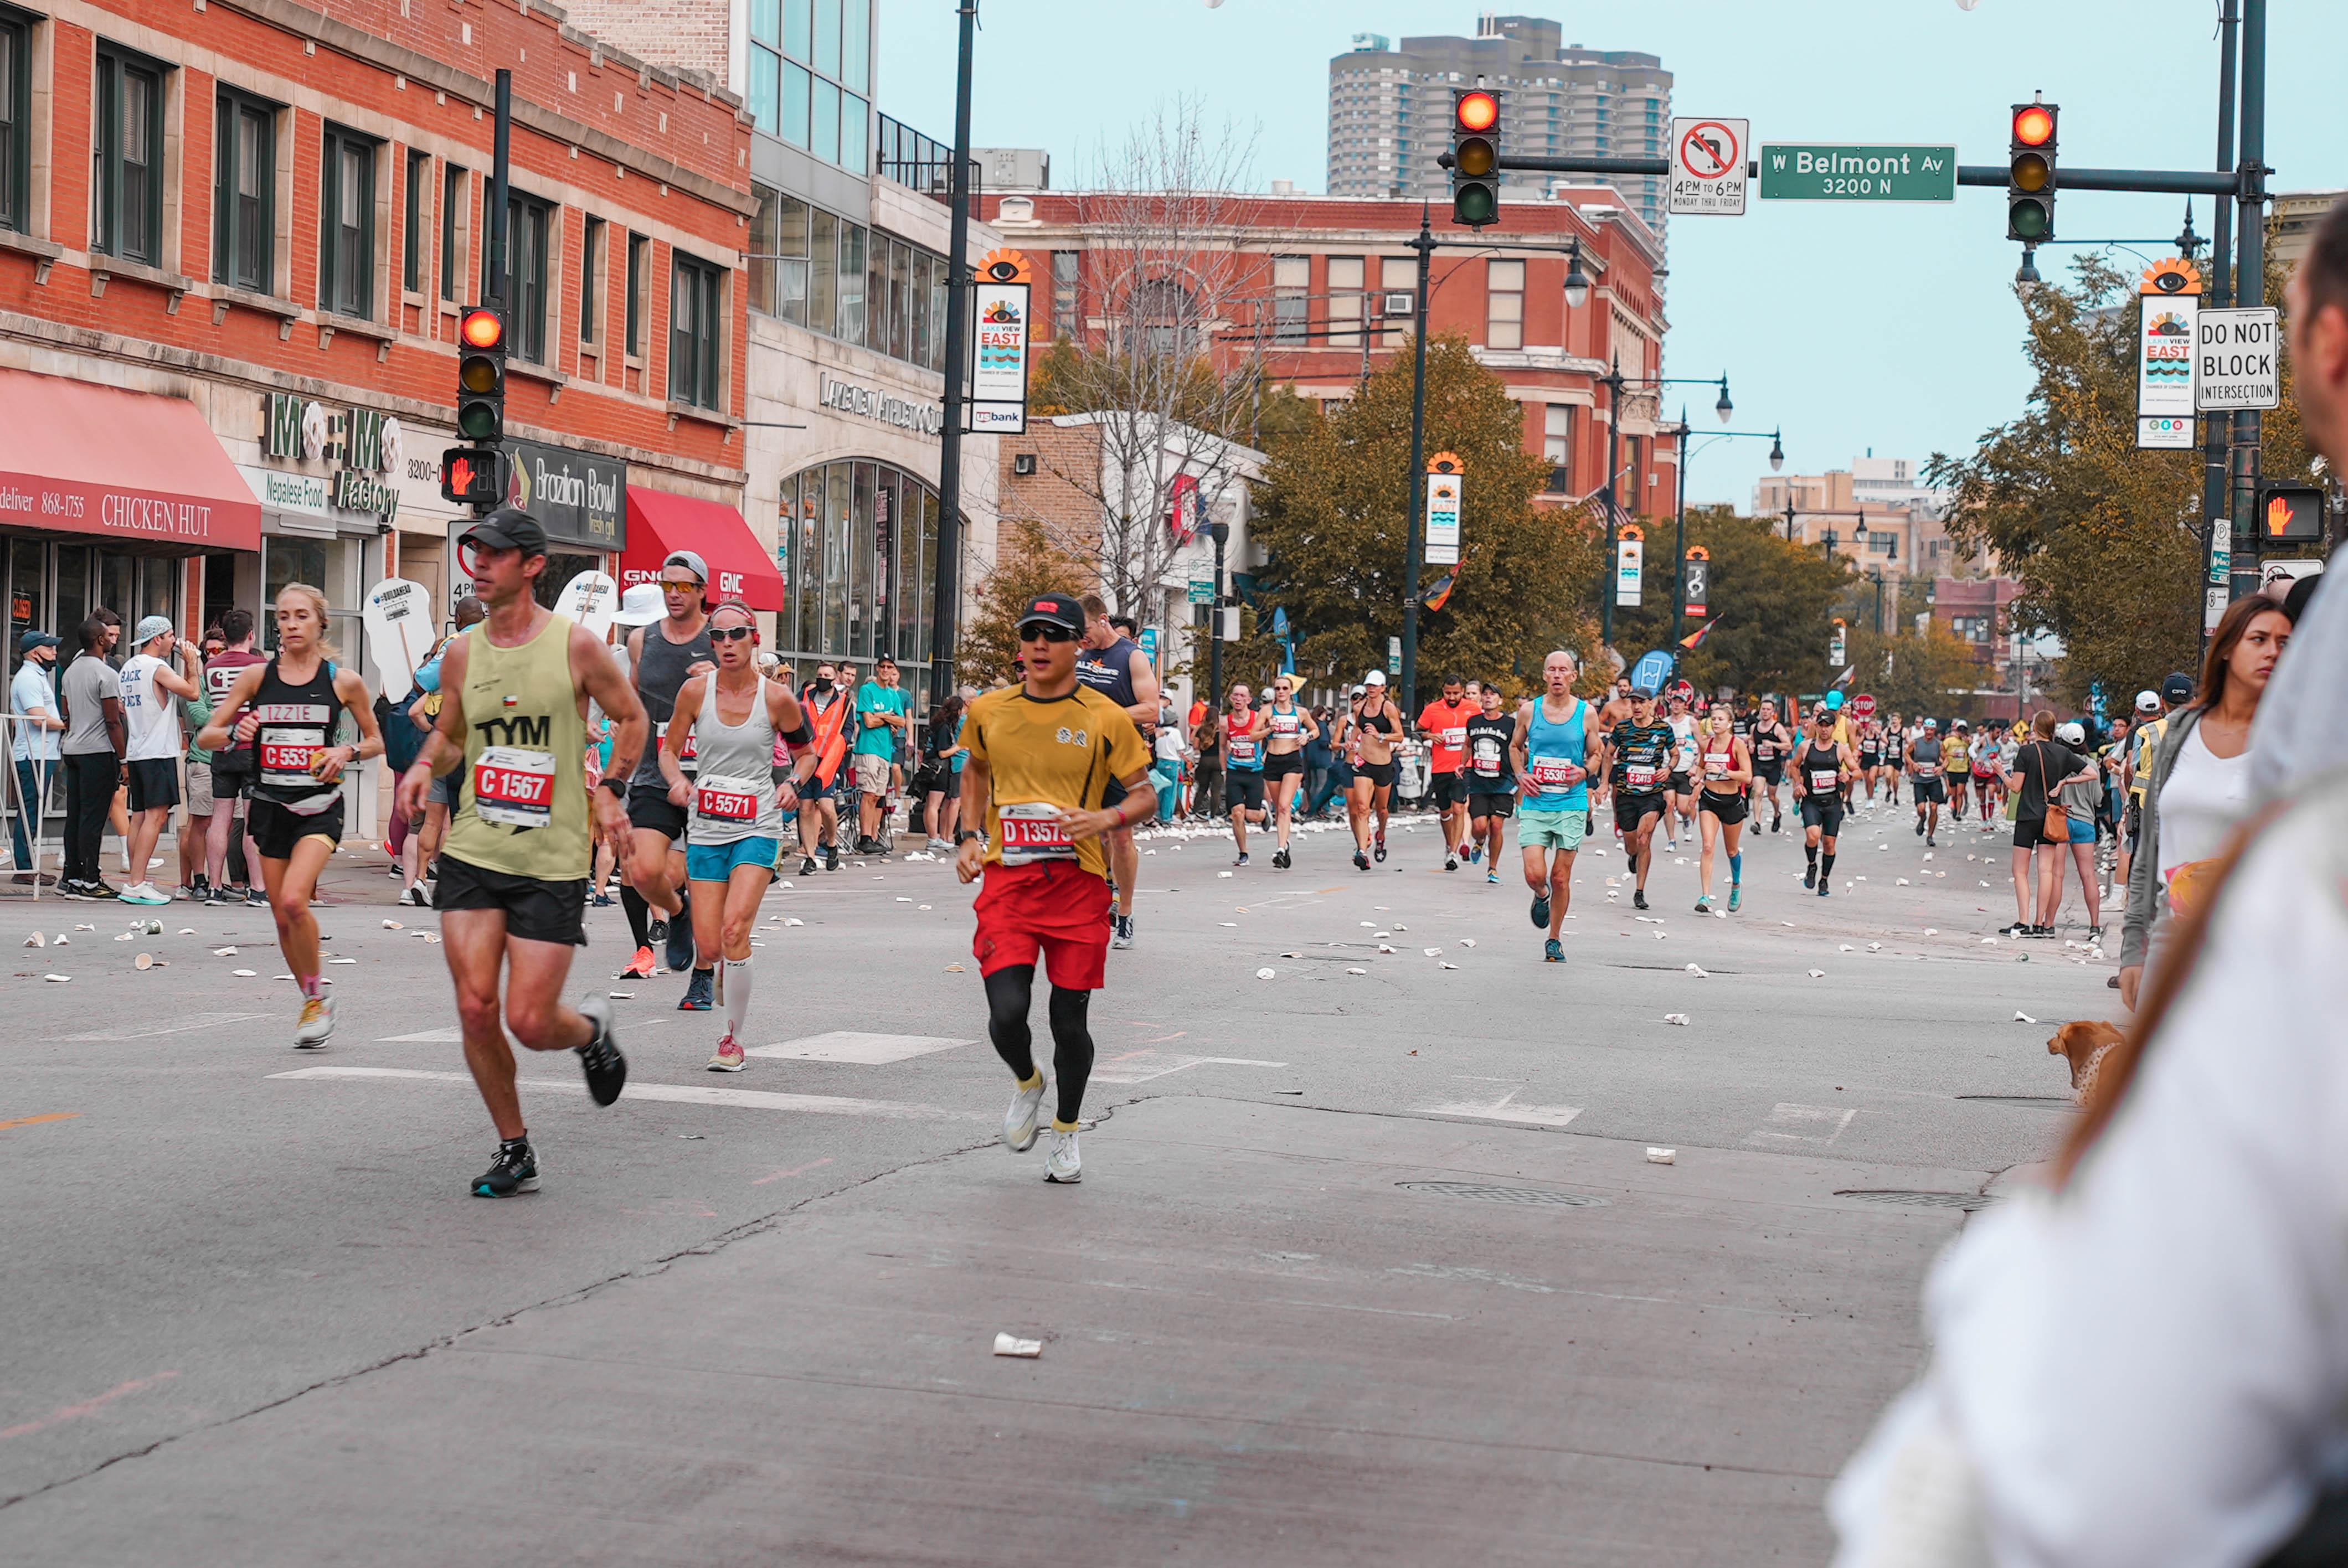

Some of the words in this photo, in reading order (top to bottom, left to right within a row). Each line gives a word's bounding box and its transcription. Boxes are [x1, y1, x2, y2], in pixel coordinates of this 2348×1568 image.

[1773, 155, 1786, 169] W
[1796, 152, 1910, 174] Belmont
[1921, 156, 1943, 171] Av
[1823, 178, 1871, 194] 3200
[1880, 179, 1891, 194] N
[1674, 198, 1698, 206] MONDAY
[1702, 198, 1716, 207] THRU
[1720, 198, 1740, 207] FRIDAY
[981, 333, 1020, 344] EAST
[2202, 324, 2226, 344] DO
[2236, 323, 2272, 343] NOT
[2147, 346, 2190, 357] EAST
[2204, 355, 2270, 376] BLOCK
[2202, 385, 2272, 399] INTERSECTION
[267, 474, 302, 507] Nepalese
[305, 480, 322, 507] Food
[336, 471, 399, 524] Factory
[588, 468, 616, 513] Bowl
[41, 492, 84, 518] 868-1755
[102, 494, 173, 532] CHICKEN
[178, 507, 210, 537] HUT
[720, 572, 743, 594] GNC
[121, 669, 141, 683] BACK
[126, 684, 132, 693] TO
[267, 706, 311, 720] IZZIE
[1855, 700, 1873, 710] STOP
[475, 716, 550, 746] TYM
[266, 747, 276, 765] C
[1536, 767, 1542, 779] C
[1629, 773, 1635, 782] C
[1635, 774, 1652, 783] 2415
[481, 770, 496, 793] C
[501, 773, 545, 800] 1567
[704, 792, 713, 810] C
[715, 795, 749, 815] 5571
[1003, 821, 1016, 842] D
